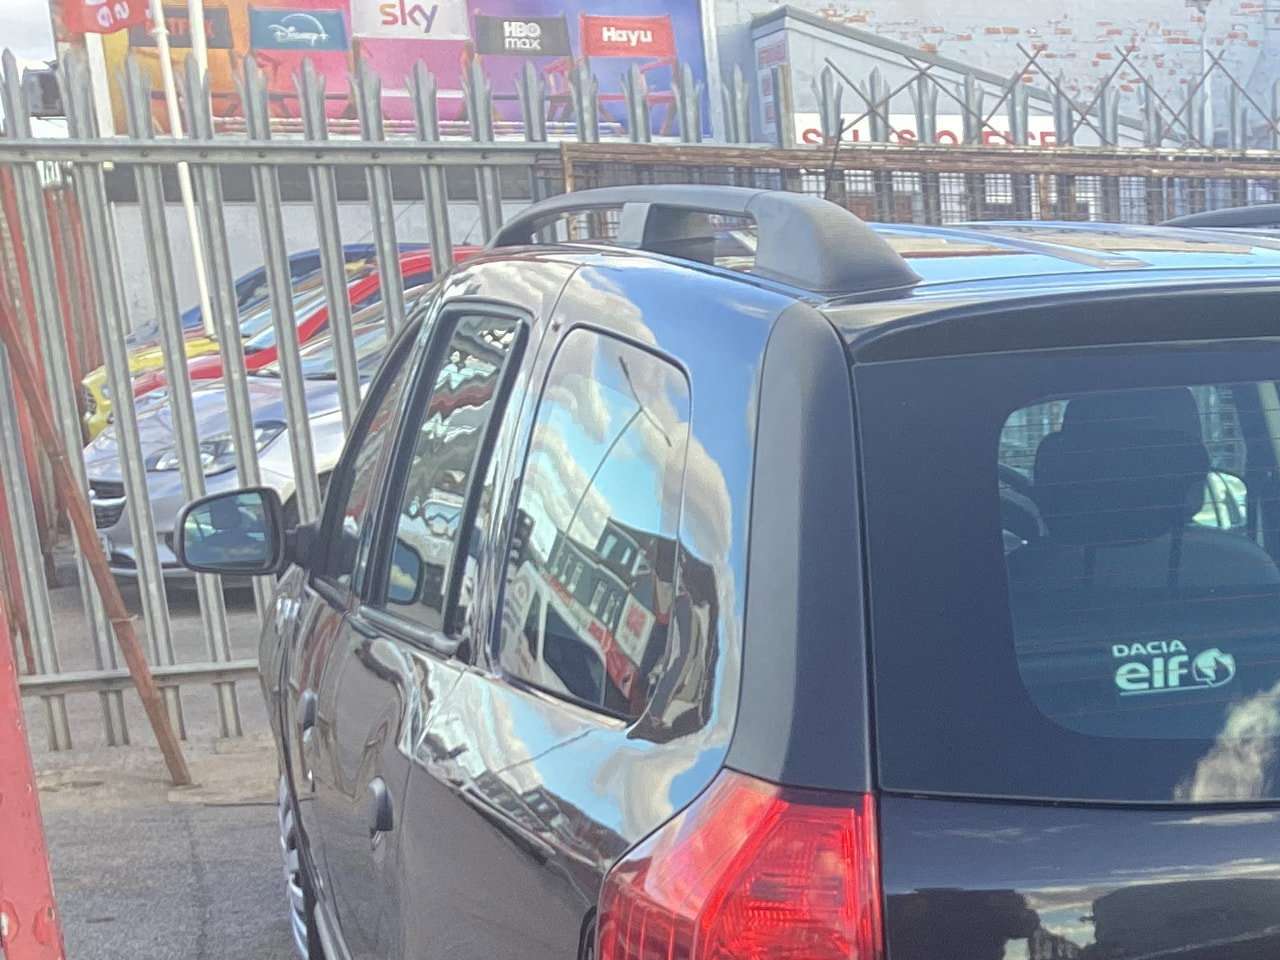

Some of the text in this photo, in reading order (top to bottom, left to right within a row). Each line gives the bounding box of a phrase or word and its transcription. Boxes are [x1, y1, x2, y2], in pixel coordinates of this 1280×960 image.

[379, 0, 438, 33] sky
[503, 21, 541, 38] HBO
[602, 26, 652, 46] Hayu
[504, 37, 541, 50] max
[1112, 640, 1187, 657] DACIA
[1115, 655, 1189, 690] elf
